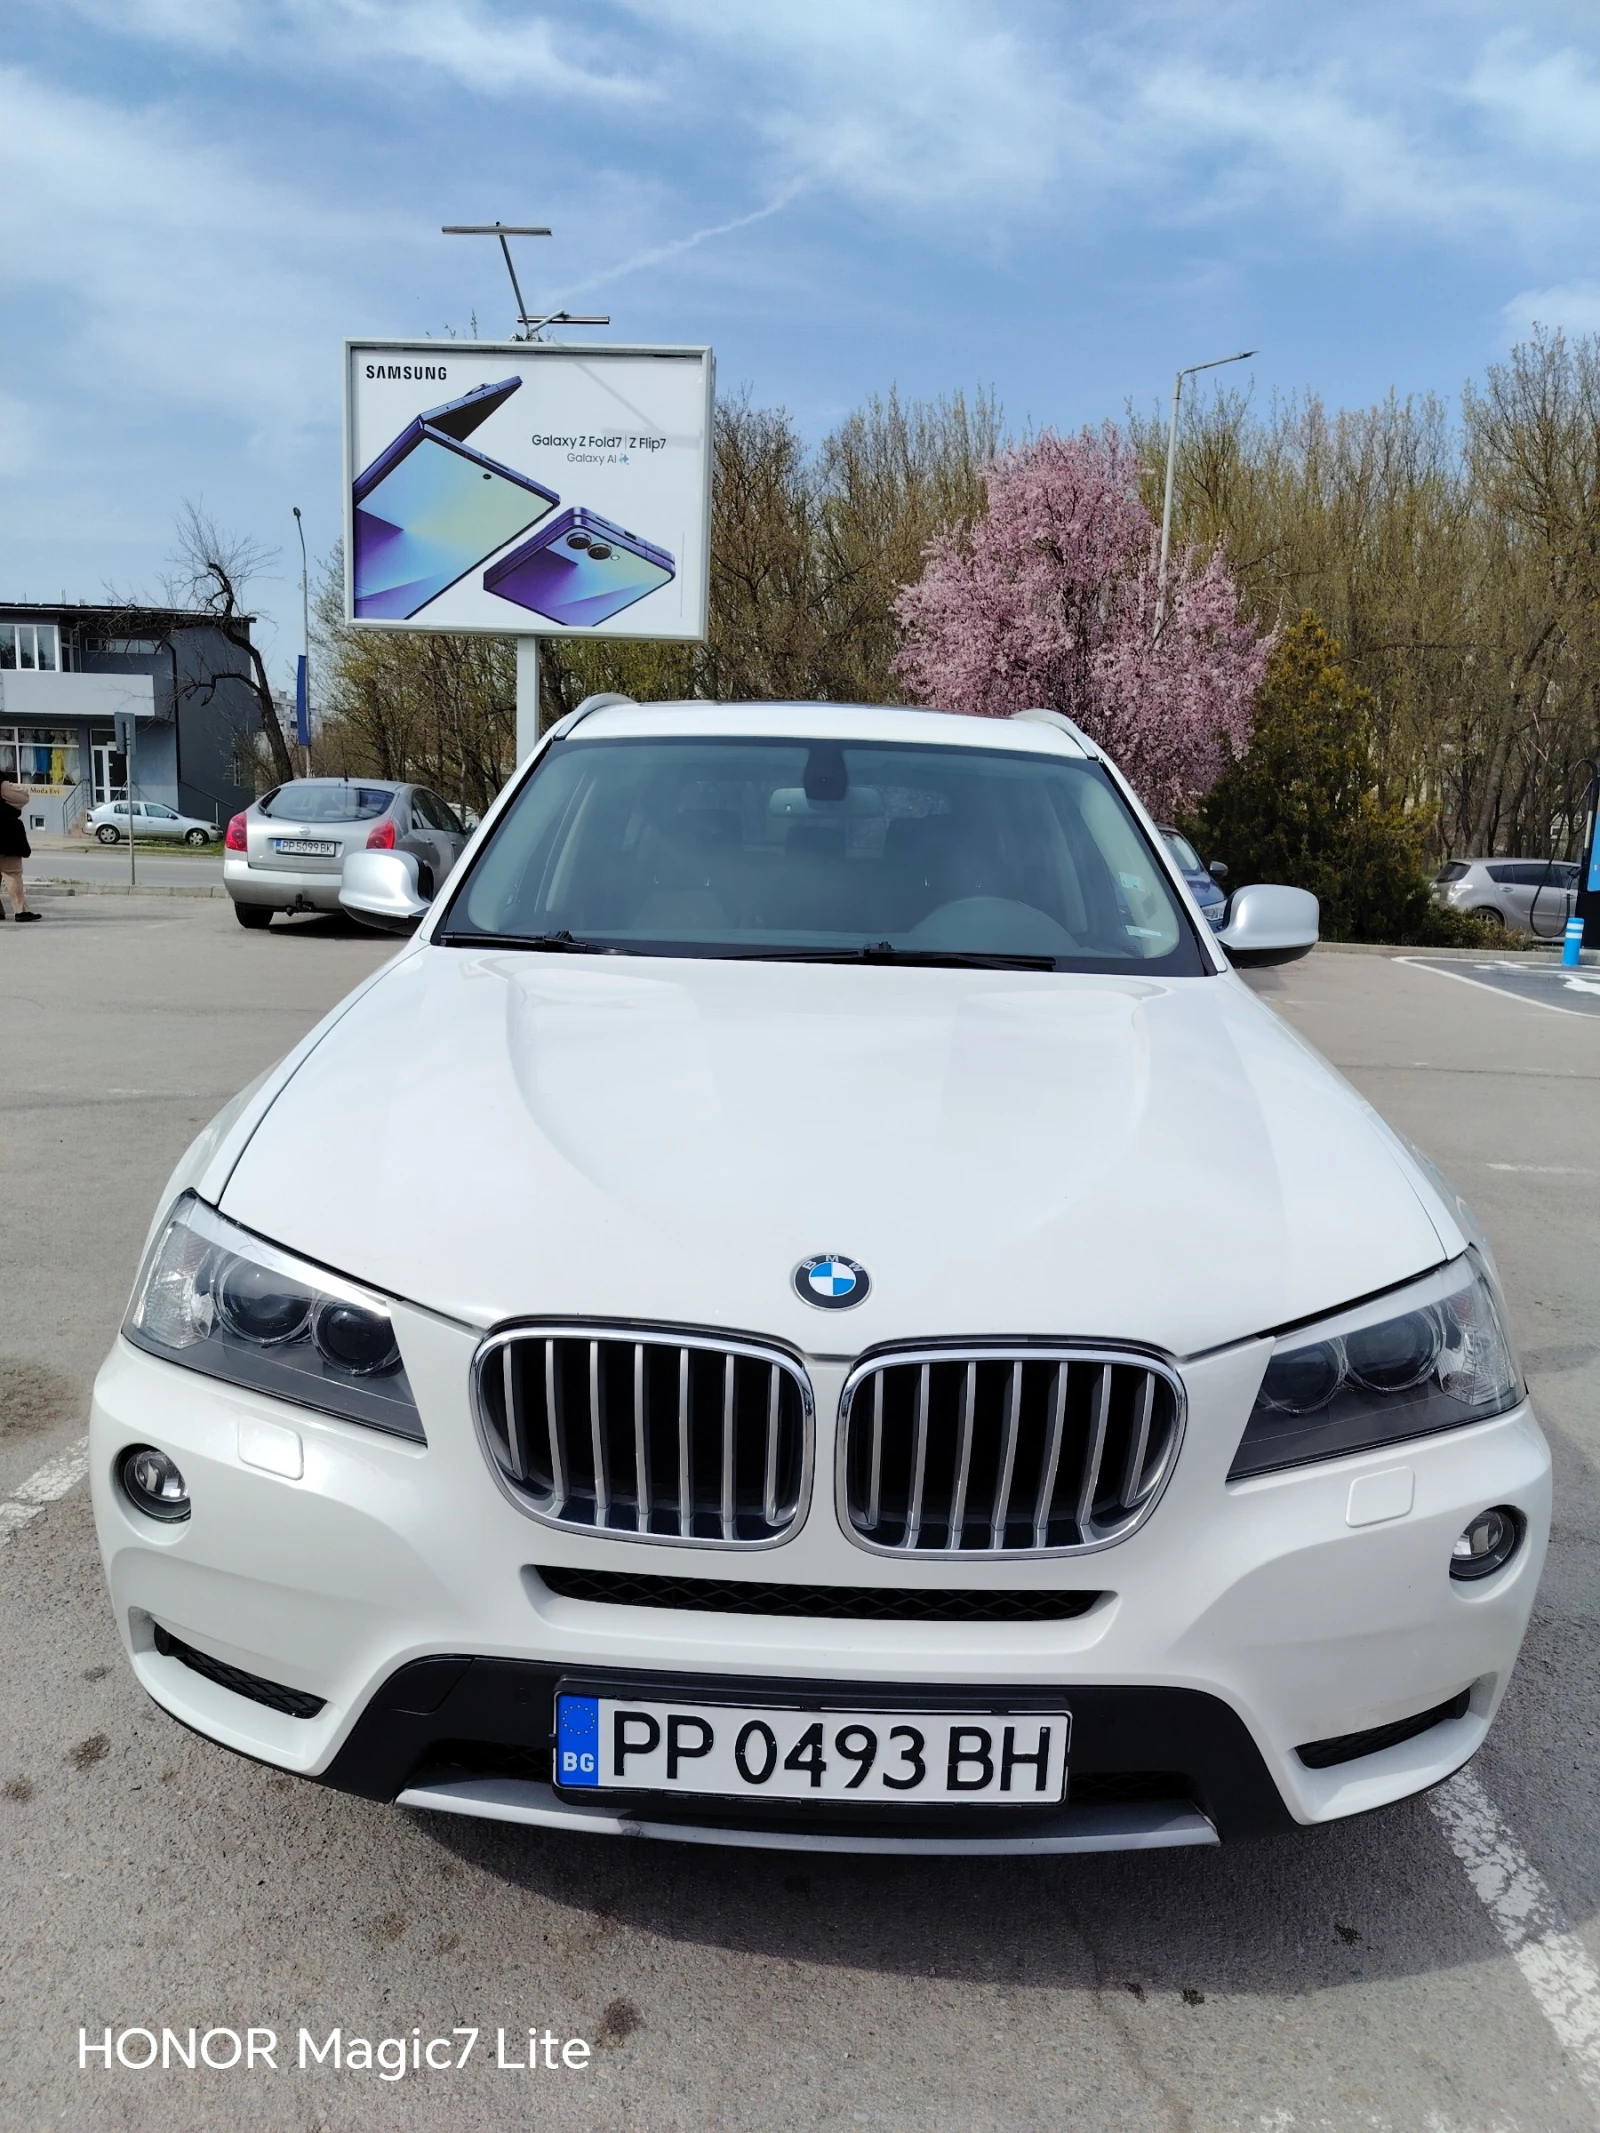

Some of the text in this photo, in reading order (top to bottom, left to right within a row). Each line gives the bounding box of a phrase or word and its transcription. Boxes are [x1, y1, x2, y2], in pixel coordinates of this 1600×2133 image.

[366, 365, 447, 380] SAMSUNG
[531, 434, 667, 453] Galaxy Z Fold7 Z Flip7
[566, 453, 617, 466] Galaxy AI
[283, 840, 295, 850] PP
[802, 1255, 864, 1272] BMW
[614, 1710, 1051, 1791] PP 0493 BH
[563, 1752, 595, 1772] BG
